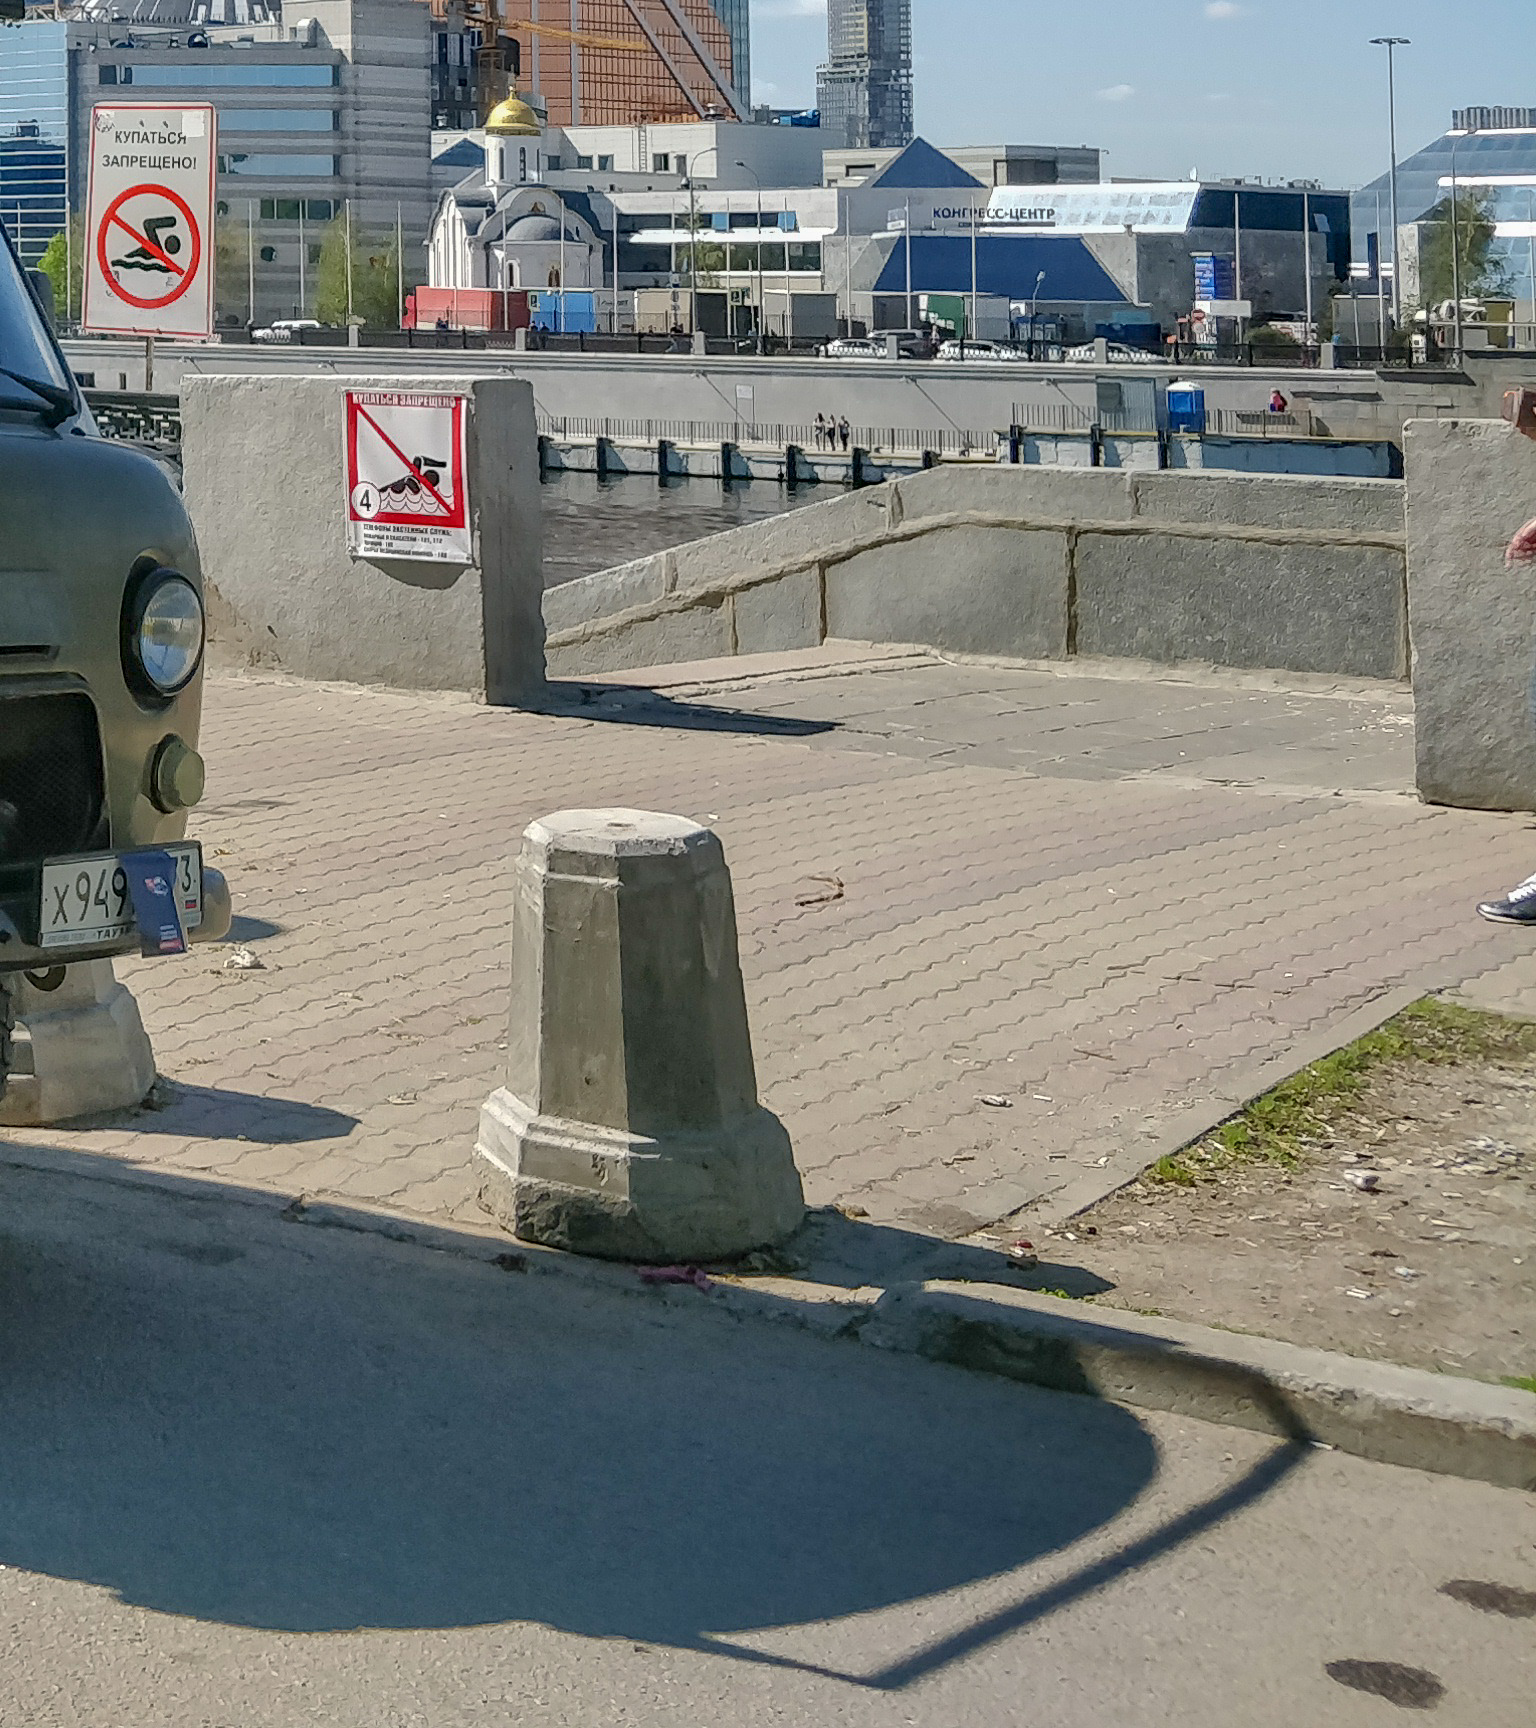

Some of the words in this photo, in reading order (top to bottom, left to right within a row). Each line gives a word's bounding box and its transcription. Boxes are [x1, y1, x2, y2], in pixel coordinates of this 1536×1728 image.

[115, 131, 187, 145] КУПАТЬСЯ
[102, 155, 197, 170] ЗАПРЕЩЕНО!
[352, 392, 398, 405] КУПАТЬСЯ
[399, 394, 456, 408] ЗАПРЕЩЕНО
[359, 489, 372, 512] 4
